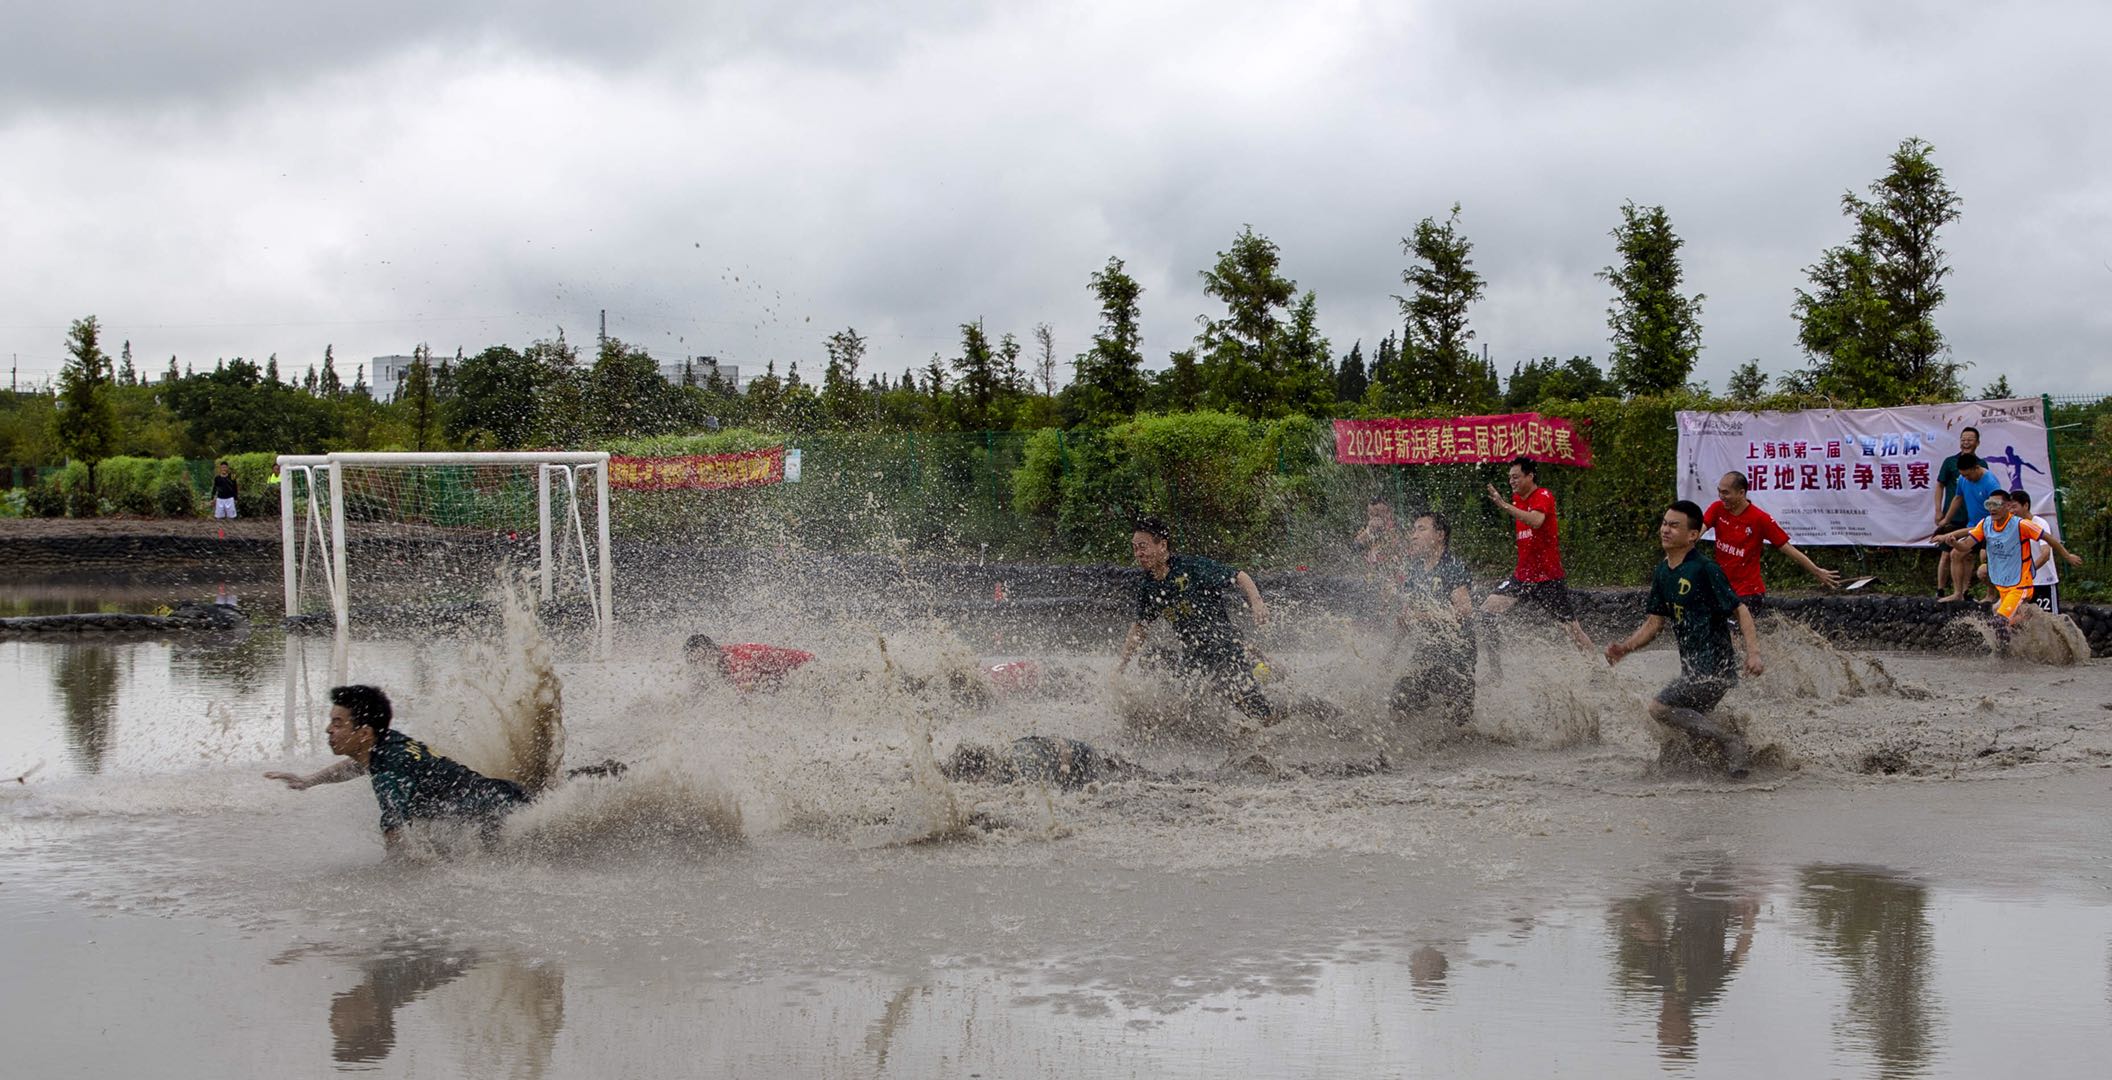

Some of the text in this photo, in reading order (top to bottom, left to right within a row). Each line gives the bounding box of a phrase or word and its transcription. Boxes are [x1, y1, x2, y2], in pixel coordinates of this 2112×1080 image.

[1347, 421, 1575, 460] 2020年新浜镇第三届泥地足球赛
[1747, 462, 1930, 490] 泥地足球争霸赛
